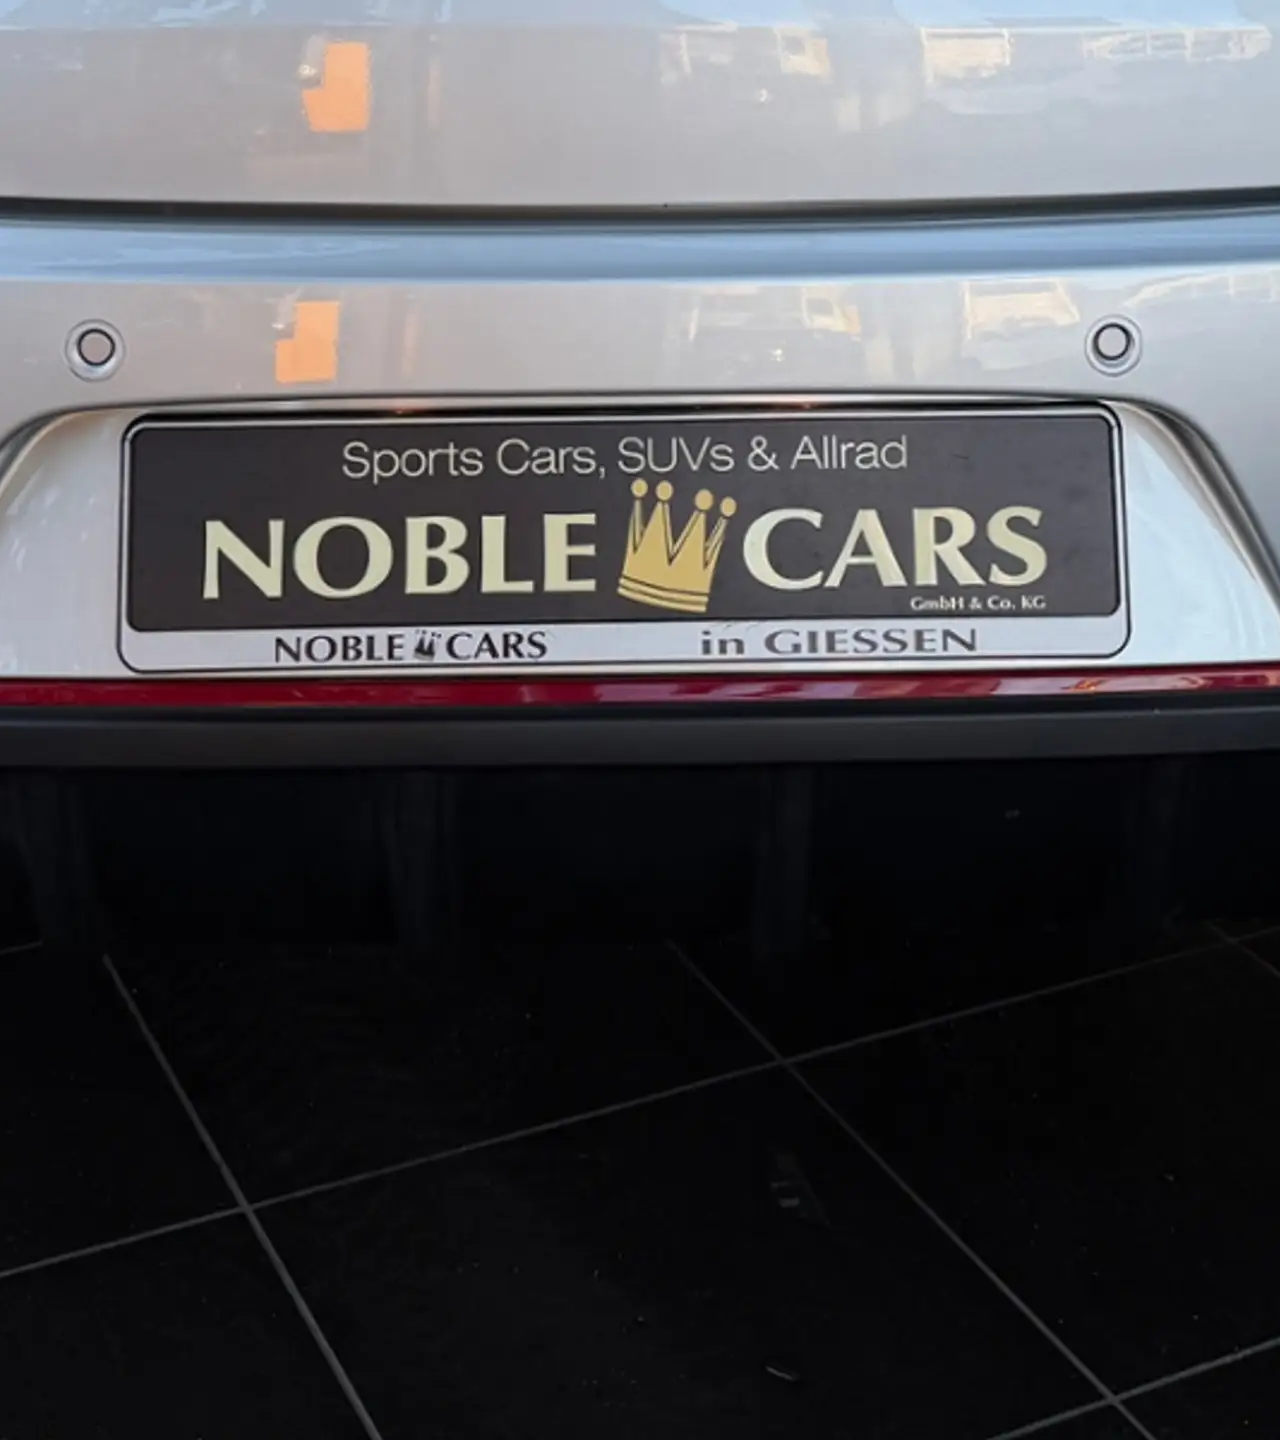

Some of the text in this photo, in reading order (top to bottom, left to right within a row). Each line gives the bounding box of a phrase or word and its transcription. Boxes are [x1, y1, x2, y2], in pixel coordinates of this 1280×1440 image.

[342, 433, 908, 484] Sports Cars, SUVs & Allrad
[202, 505, 1047, 601] NOBLE CARS
[910, 594, 965, 611] GmbH
[969, 596, 983, 610] &
[1020, 594, 1047, 610] KG
[274, 628, 977, 664] NOBLE CARS in GIESSEN
